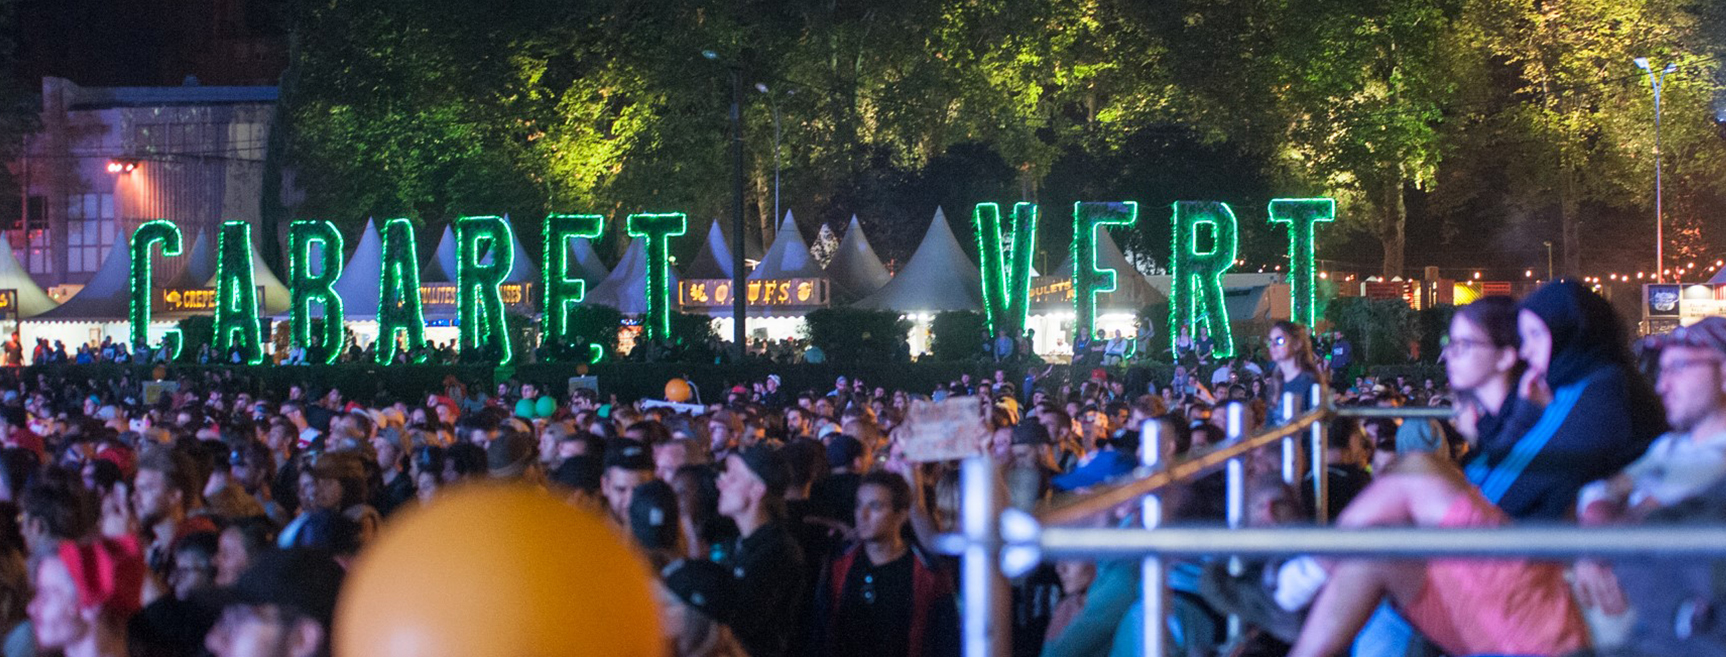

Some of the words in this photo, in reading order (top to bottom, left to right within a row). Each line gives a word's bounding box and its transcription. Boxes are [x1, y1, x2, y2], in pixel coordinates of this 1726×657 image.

[131, 212, 687, 366] CABARET
[975, 198, 1336, 360] VERT
[1029, 280, 1072, 298] OULETS
[183, 290, 217, 308] CREPE
[714, 281, 791, 304] OUFS
